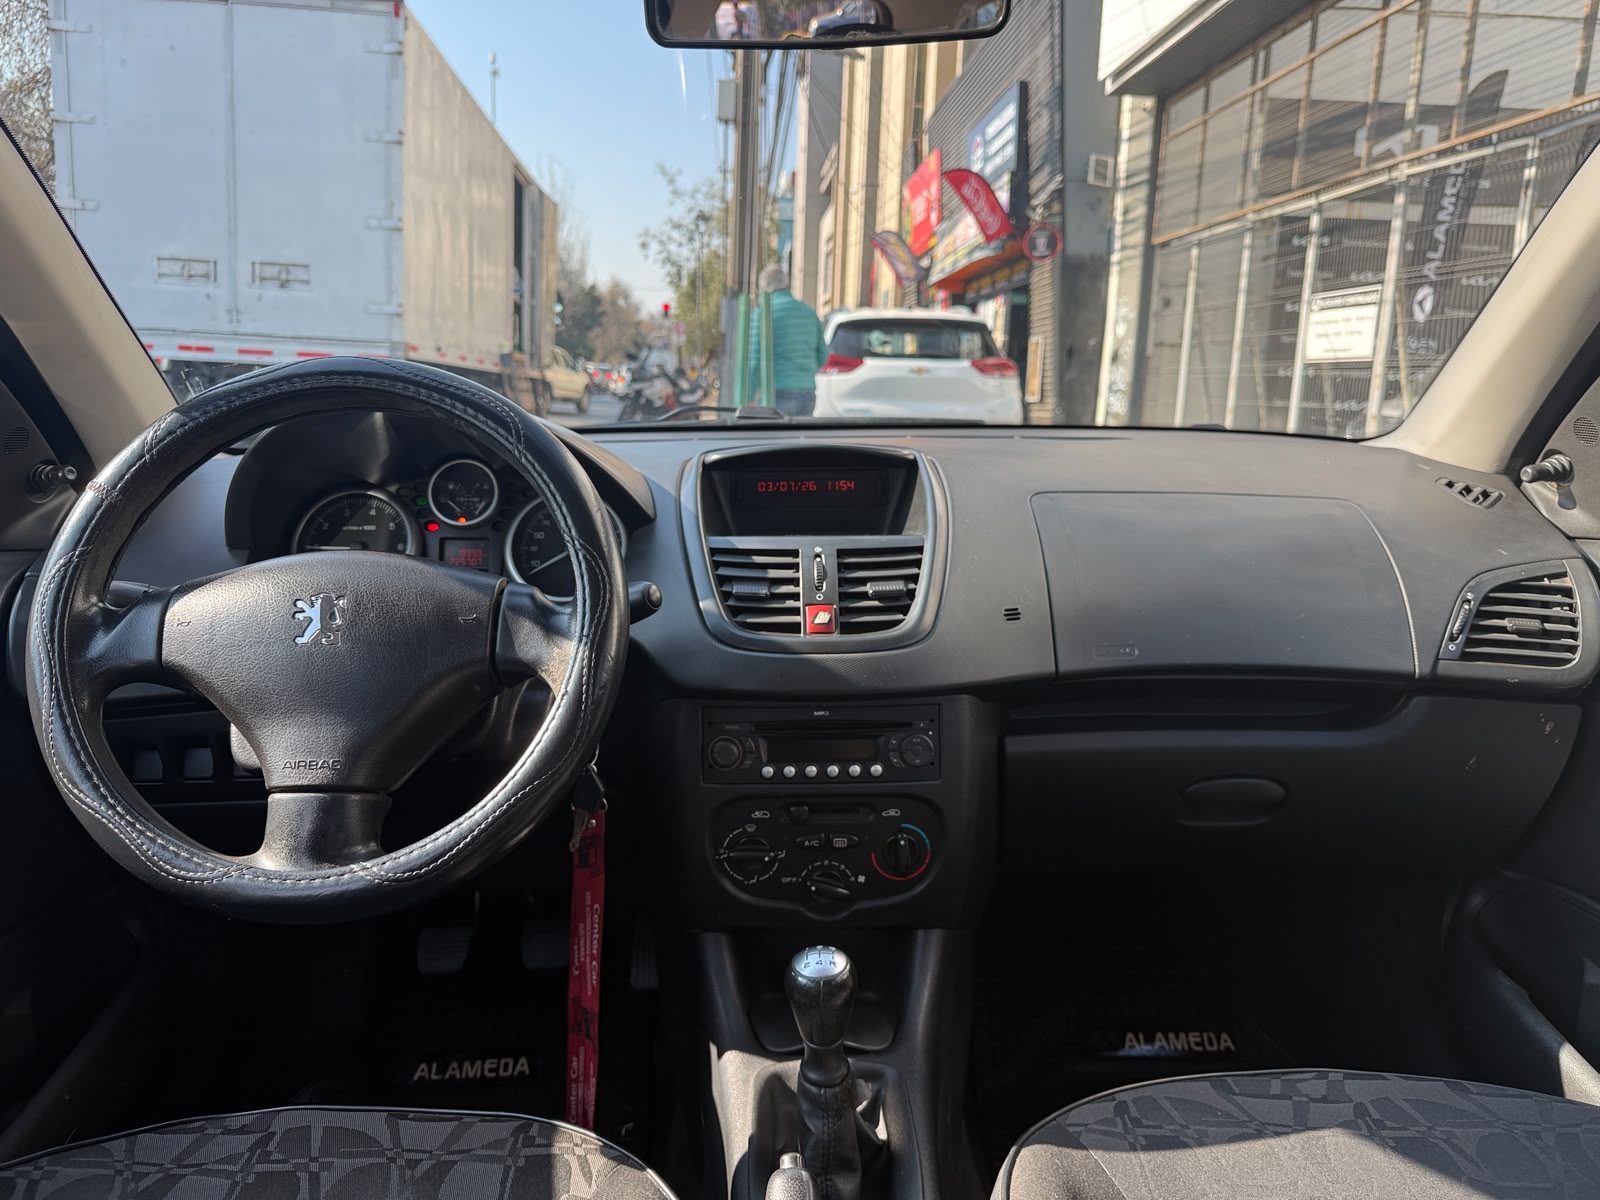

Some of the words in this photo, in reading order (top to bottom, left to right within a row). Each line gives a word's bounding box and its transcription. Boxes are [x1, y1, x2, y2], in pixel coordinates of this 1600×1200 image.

[757, 480, 817, 492] 03/07/26
[389, 522, 396, 530] 5
[281, 758, 342, 771] AIRBAG
[804, 839, 819, 847] A/C
[592, 903, 601, 958] Center
[829, 960, 838, 969] R
[1124, 1030, 1236, 1052] ALAMEDA
[412, 1055, 530, 1082] ALAMEDA
[570, 1056, 578, 1079] Car
[570, 1079, 578, 1123] Center
